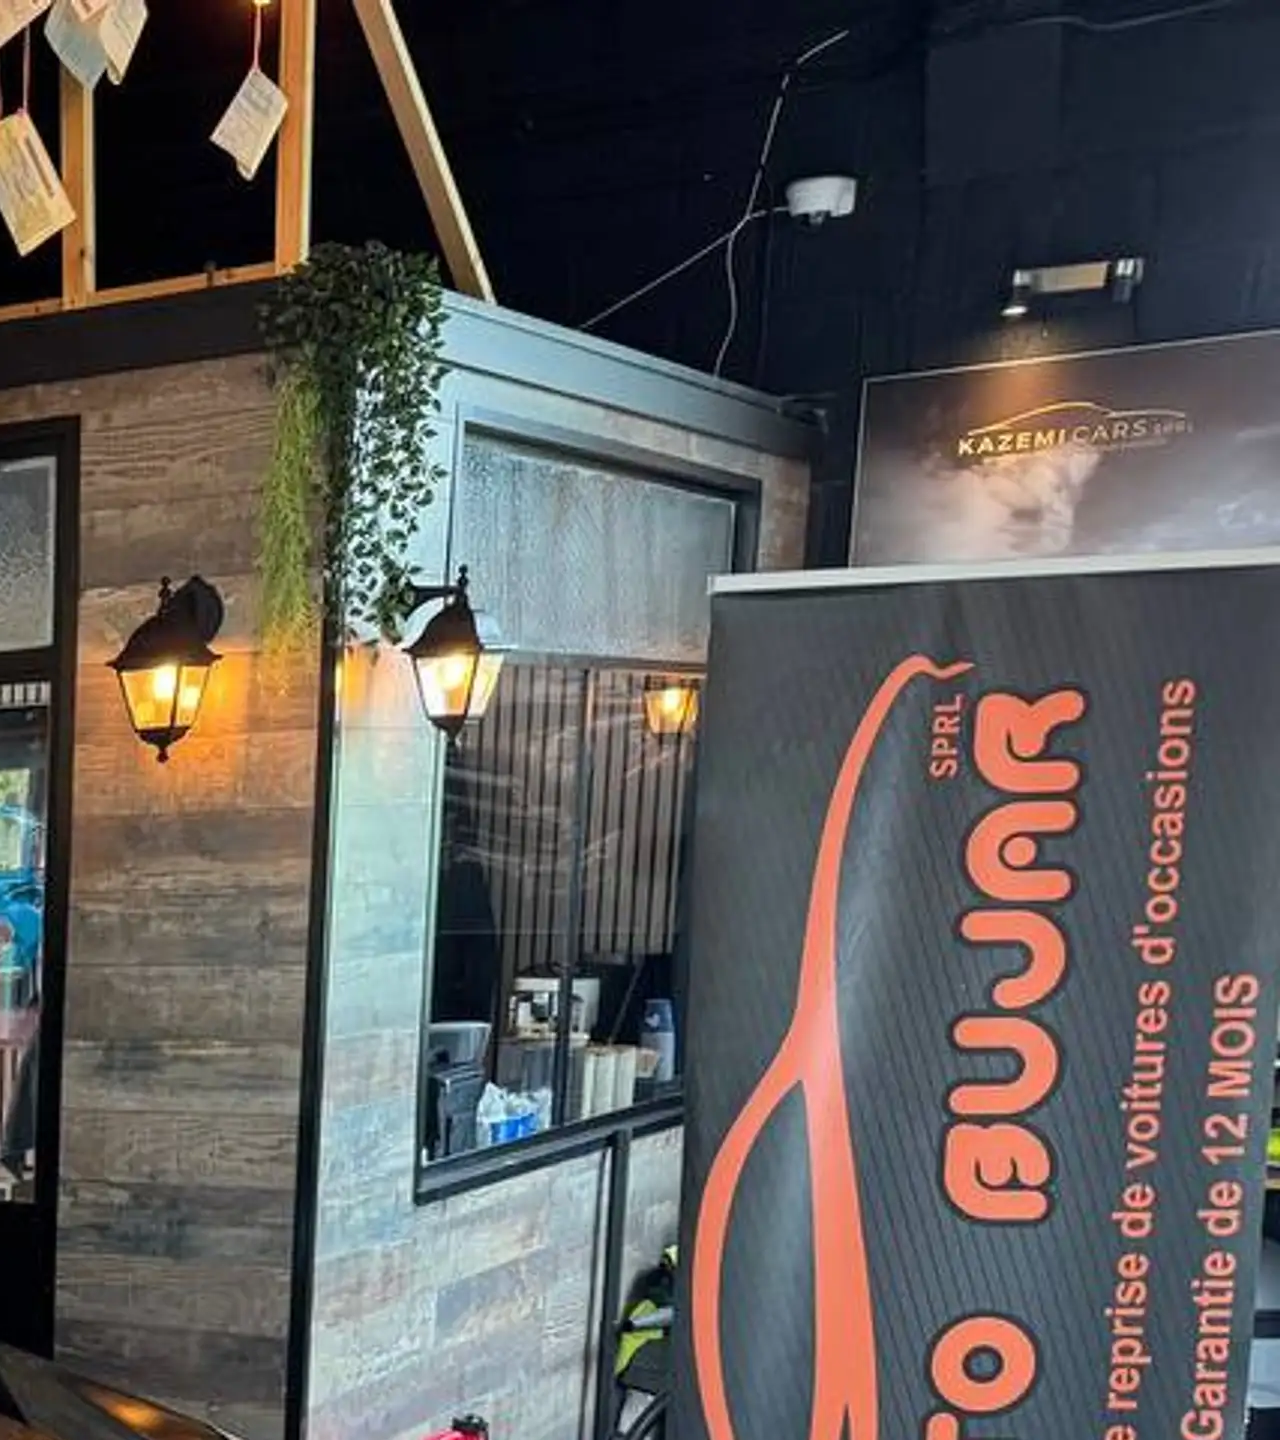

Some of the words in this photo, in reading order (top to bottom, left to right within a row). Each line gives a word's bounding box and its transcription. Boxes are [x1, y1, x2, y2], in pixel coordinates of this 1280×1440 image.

[957, 428, 1066, 456] KAZEMI
[1072, 418, 1148, 444] CARS
[929, 694, 965, 778] SPRL
[1132, 678, 1196, 965] d'occasions
[943, 690, 1086, 1220] BUJAR
[1120, 980, 1170, 1168] voitures
[1209, 973, 1260, 1099] MOIS
[1203, 1113, 1246, 1163] 12
[1112, 1184, 1152, 1237] de
[1198, 1183, 1241, 1236] de
[1104, 1253, 1152, 1410] reprise
